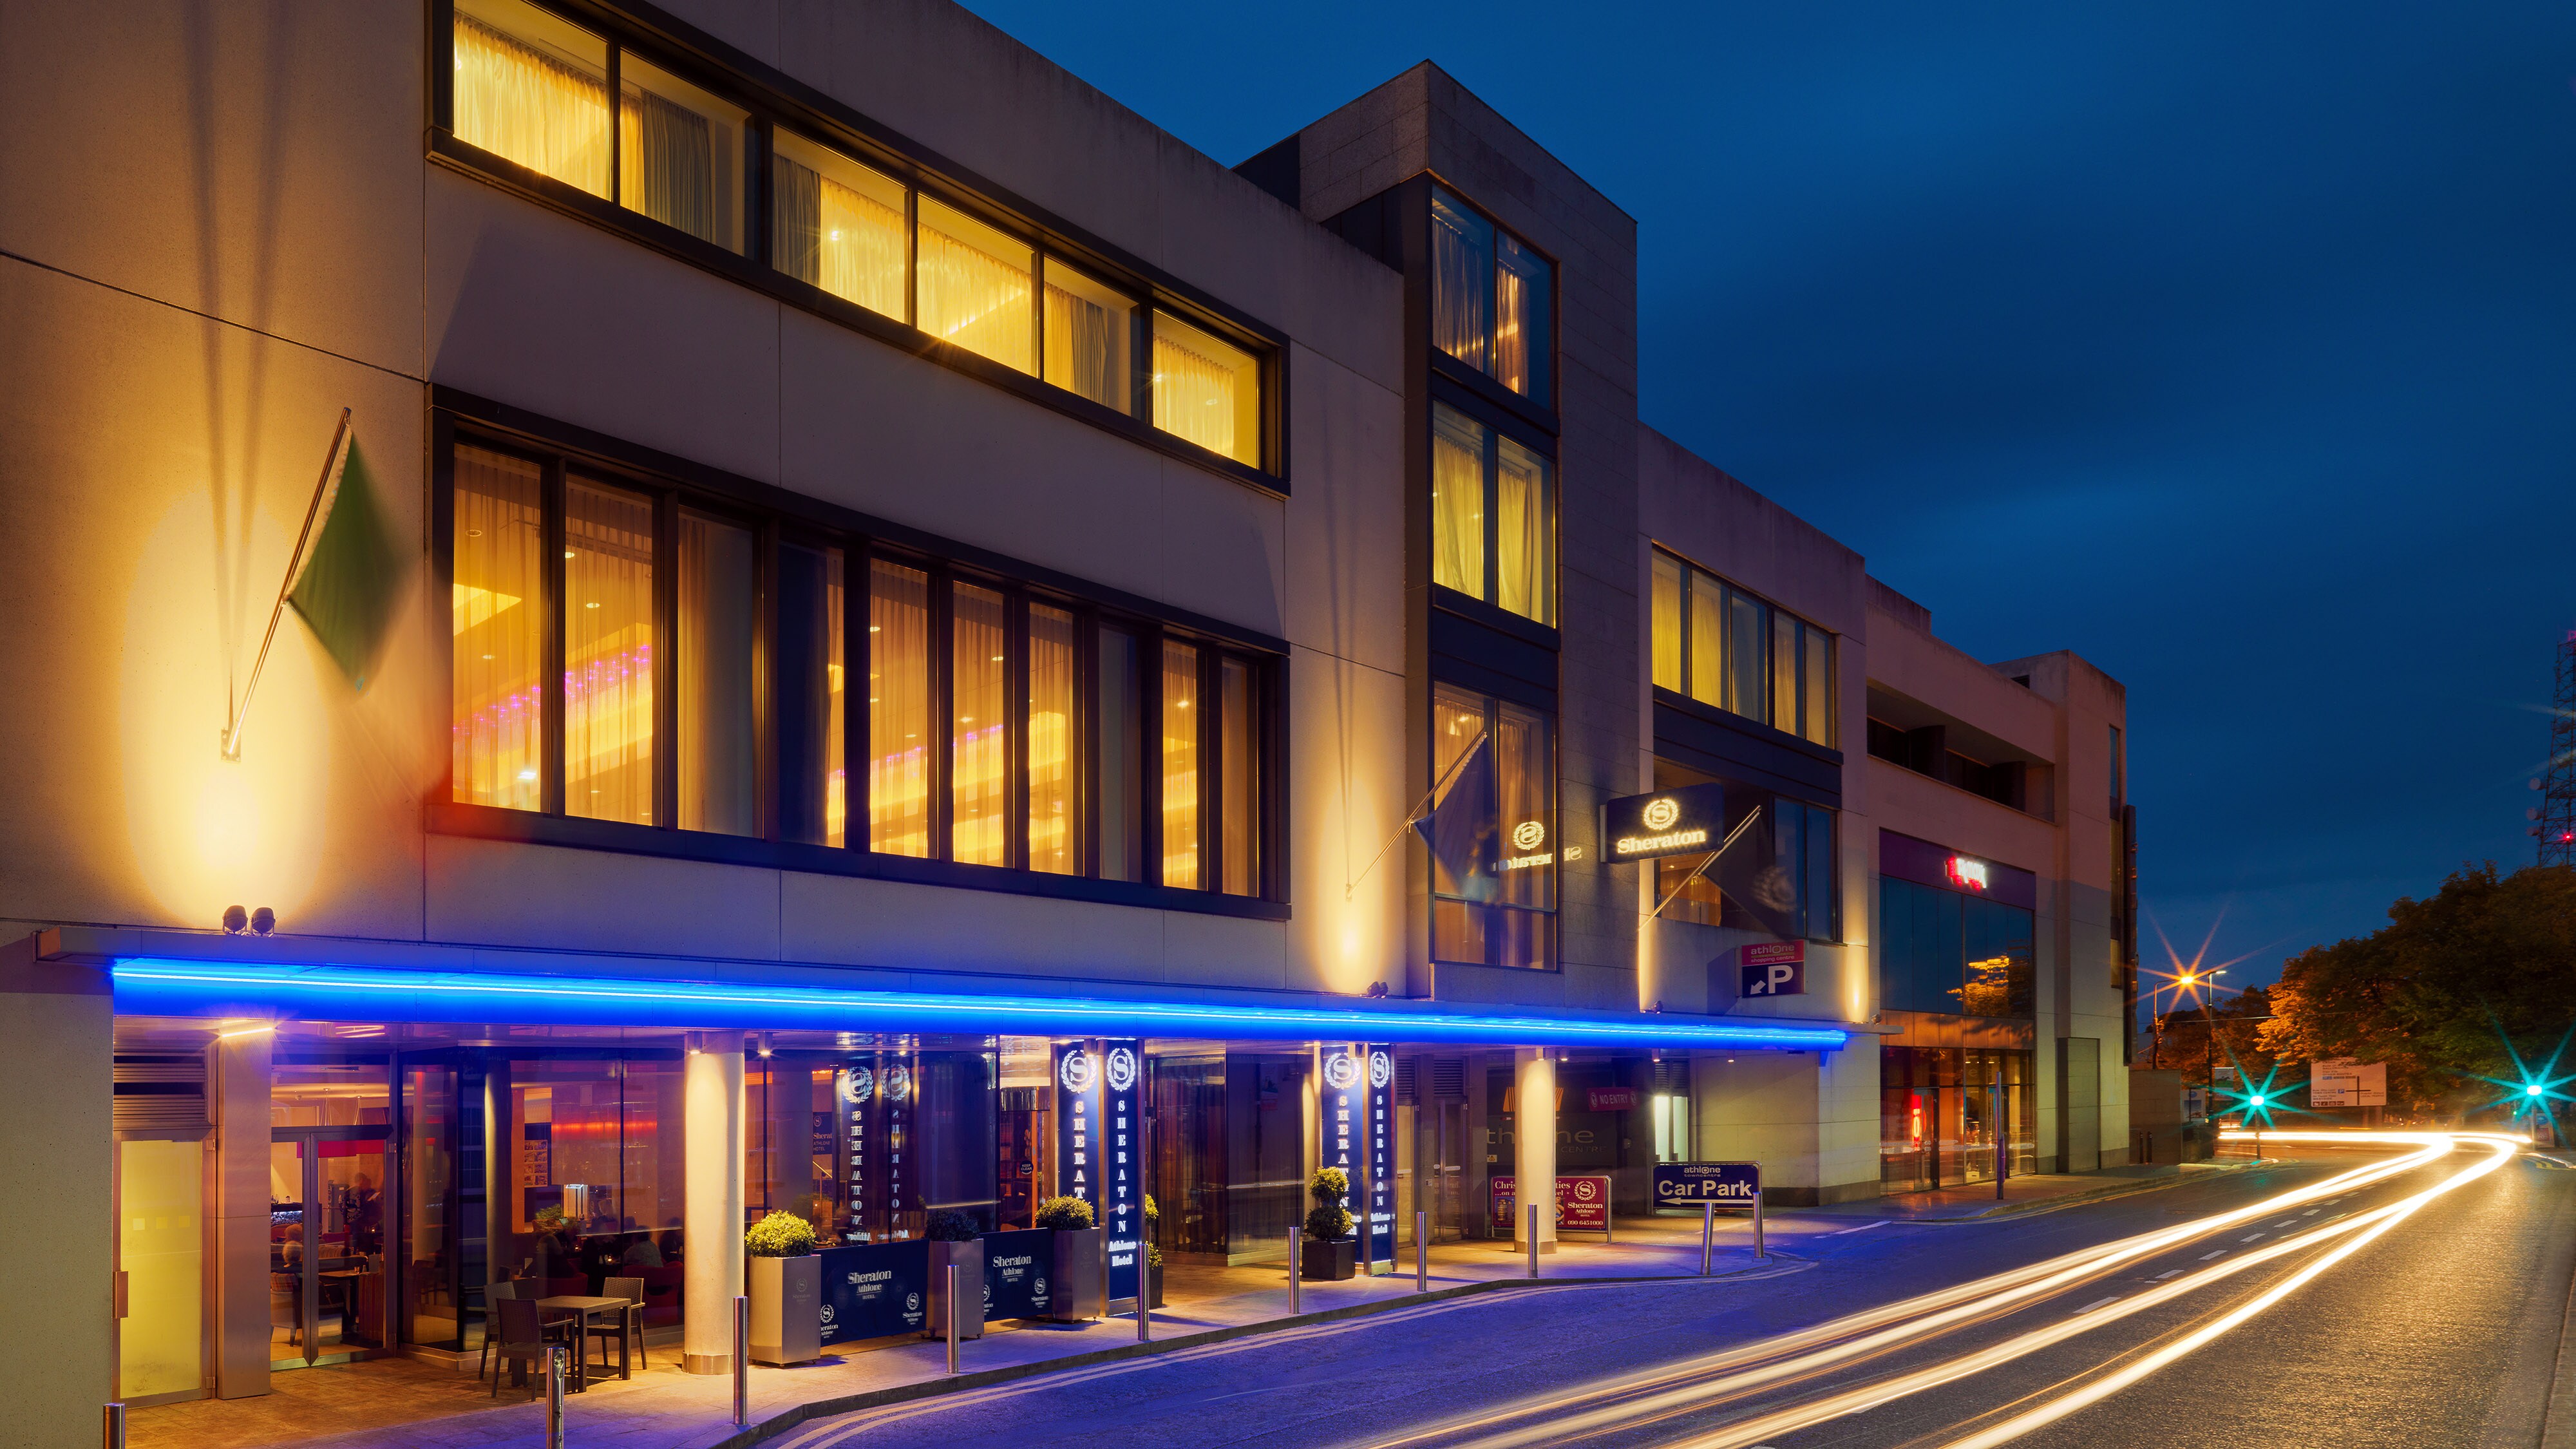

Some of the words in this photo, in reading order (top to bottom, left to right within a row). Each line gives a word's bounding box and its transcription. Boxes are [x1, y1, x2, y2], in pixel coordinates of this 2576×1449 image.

[1651, 805, 1670, 823] S
[1617, 830, 1706, 854] Sheraton
[1768, 965, 1794, 994] P
[1070, 1057, 1089, 1082] S
[1113, 1056, 1130, 1081] S
[1333, 1059, 1352, 1080] S
[1373, 1058, 1385, 1079] S
[1599, 1095, 1608, 1104] NO
[1609, 1094, 1627, 1104] ENTRY
[1074, 1101, 1085, 1199] SHERAT
[1338, 1096, 1350, 1208] SHERATN
[1117, 1100, 1126, 1233] SHERATON
[1579, 1184, 1591, 1196] S
[1658, 1180, 1696, 1196] Car
[1702, 1180, 1752, 1196] Park
[1108, 1240, 1137, 1253] Athlone
[993, 1255, 1032, 1267] Sheraton
[1112, 1254, 1133, 1267] Hotel
[848, 1270, 892, 1284] Sheraton
[1002, 1267, 1024, 1276] Athlone
[857, 1283, 882, 1293] Athlone
